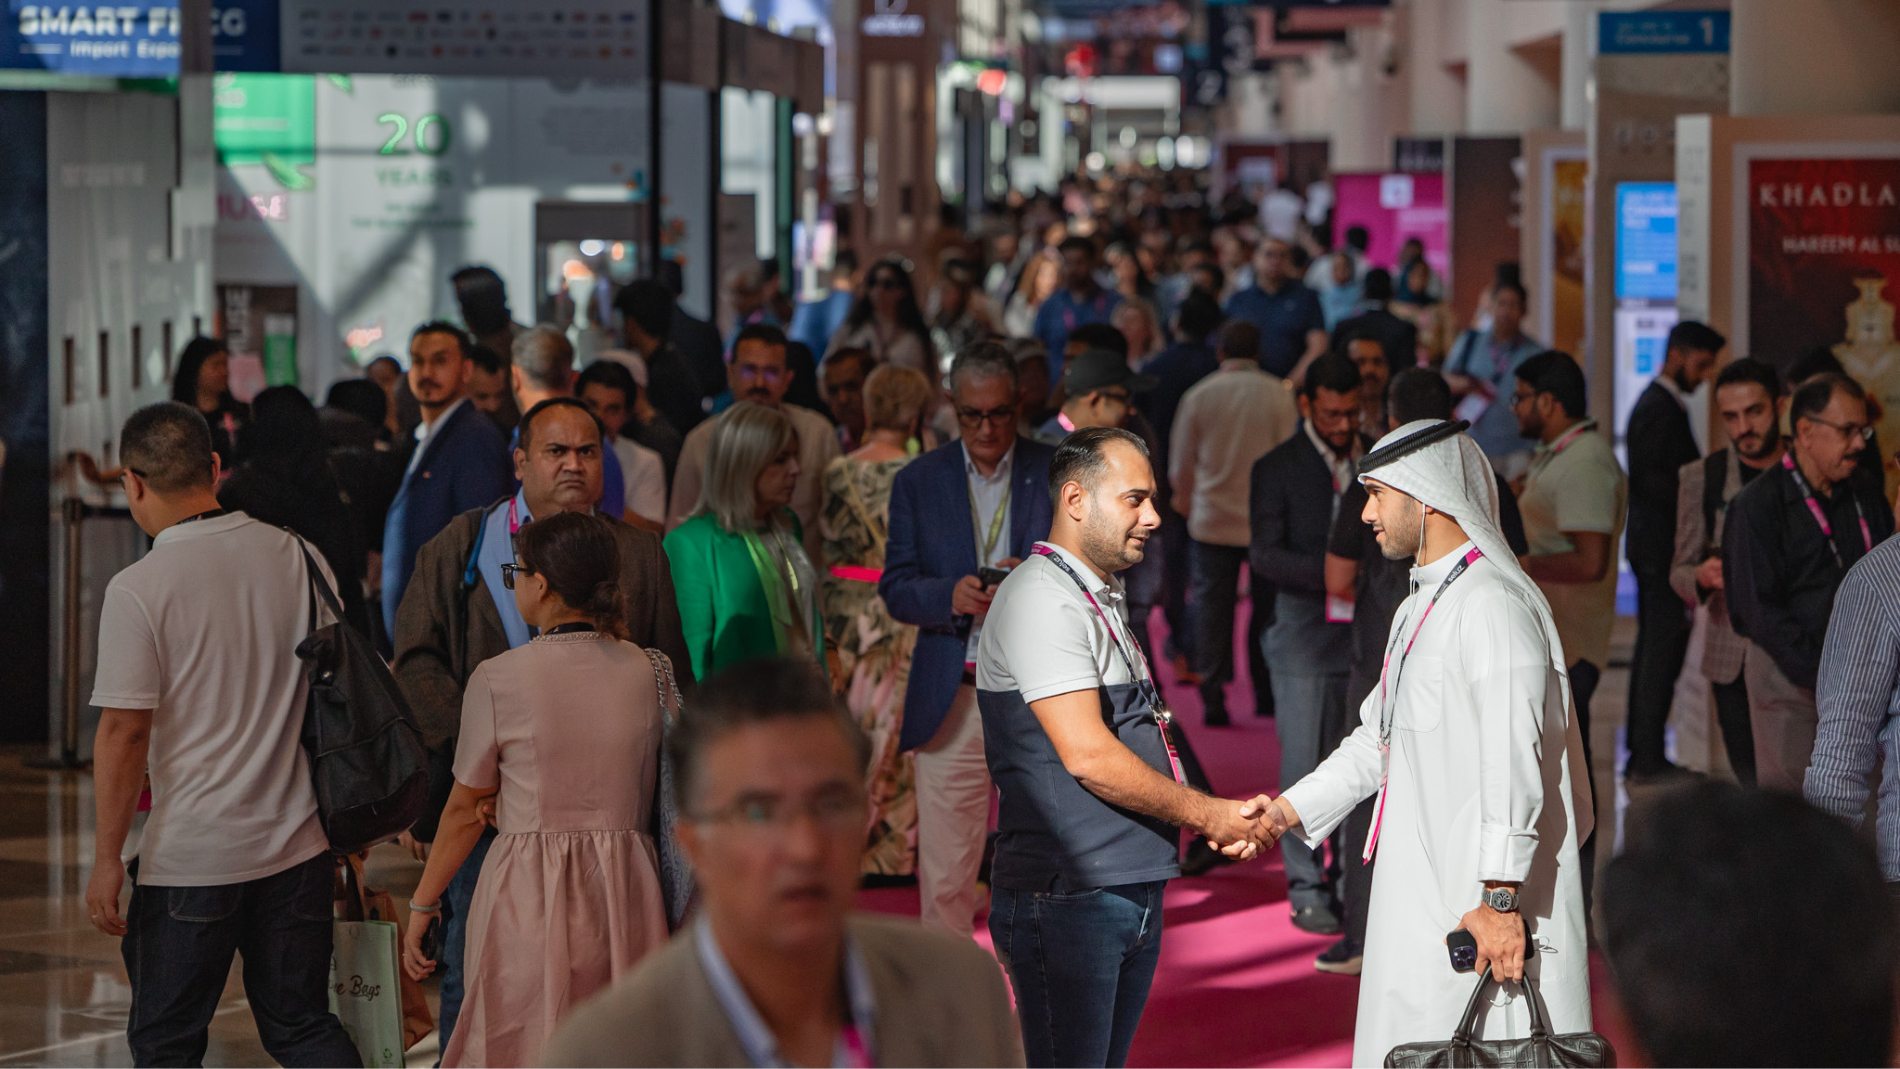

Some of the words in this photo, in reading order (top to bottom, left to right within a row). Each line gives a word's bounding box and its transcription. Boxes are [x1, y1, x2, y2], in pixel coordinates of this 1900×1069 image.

[19, 5, 139, 36] SMART
[1700, 17, 1713, 45] 1
[70, 38, 129, 58] Import
[379, 113, 451, 157] 20
[1760, 182, 1896, 207] KHADLA
[350, 975, 381, 1001] Bags
